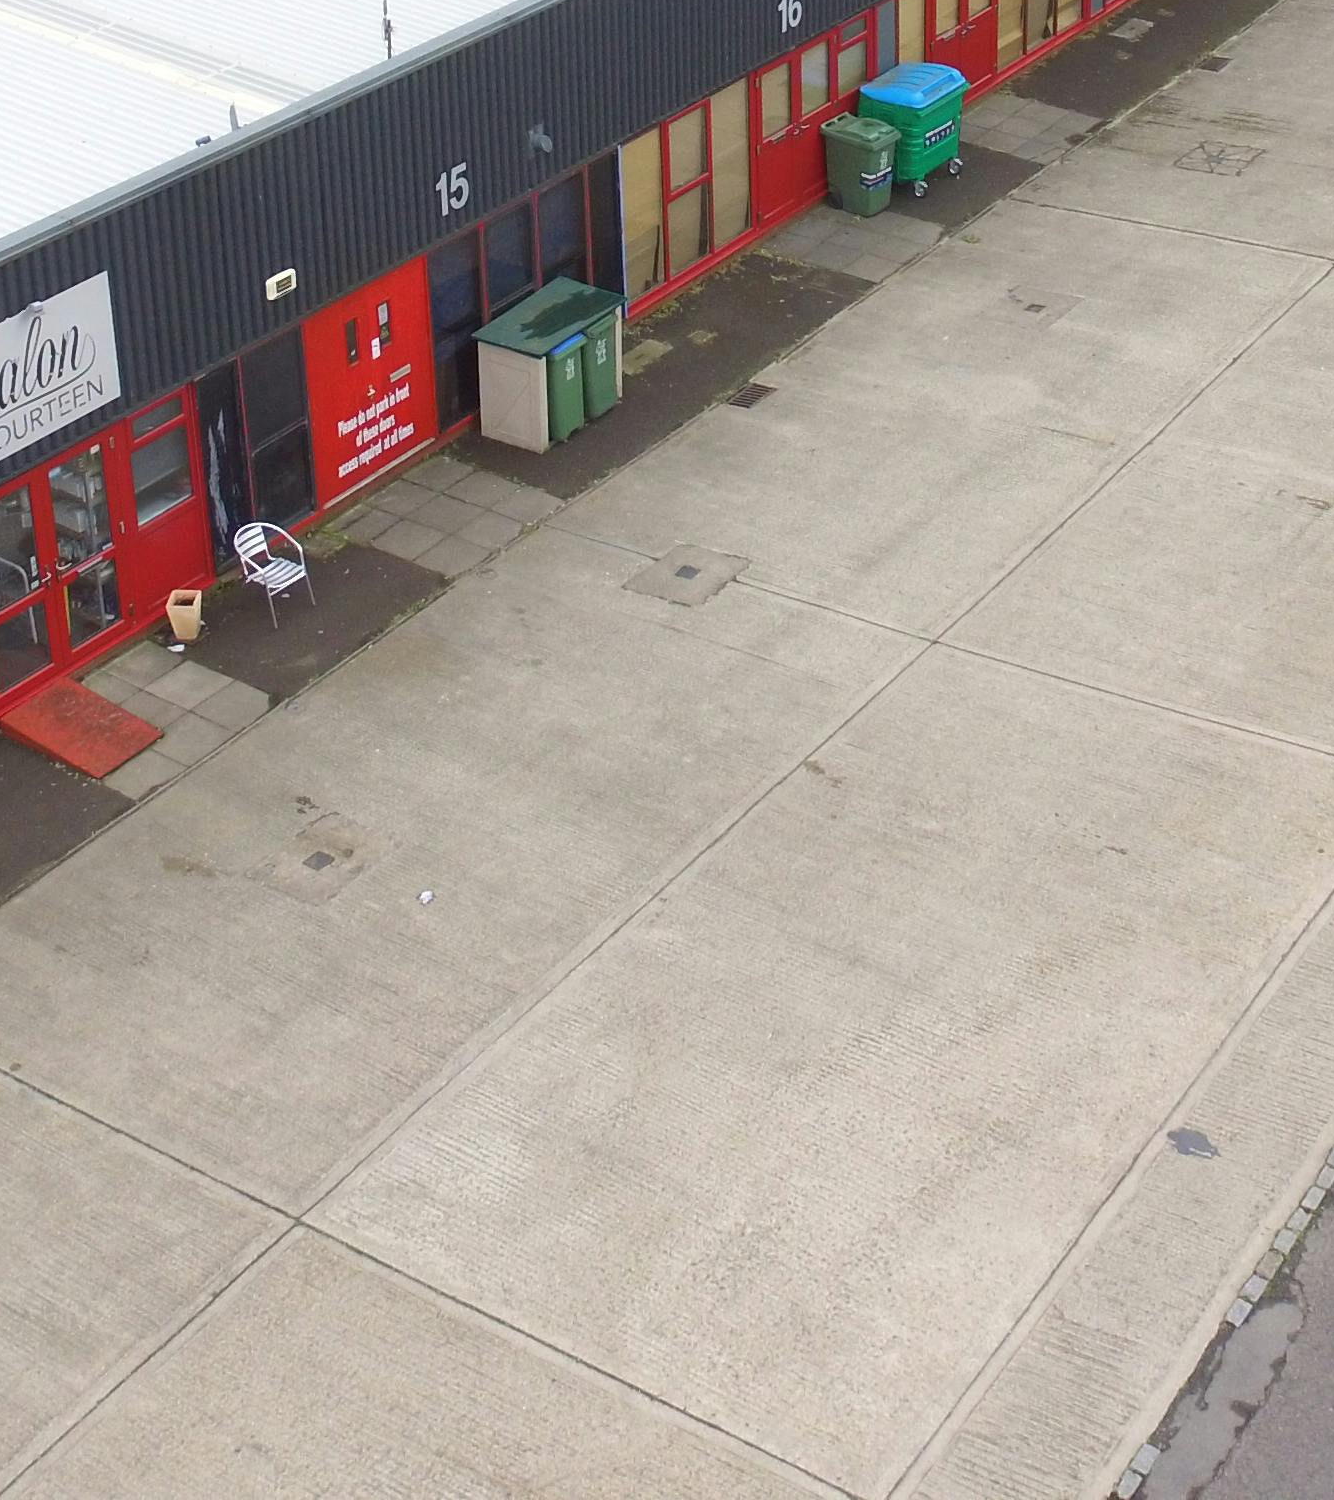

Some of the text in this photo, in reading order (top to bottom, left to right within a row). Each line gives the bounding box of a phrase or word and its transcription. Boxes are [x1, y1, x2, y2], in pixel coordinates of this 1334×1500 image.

[435, 162, 470, 217] 15
[338, 417, 358, 438] Please
[358, 410, 366, 426] do
[376, 394, 390, 419] park
[338, 456, 359, 479] access
[359, 438, 383, 466] required
